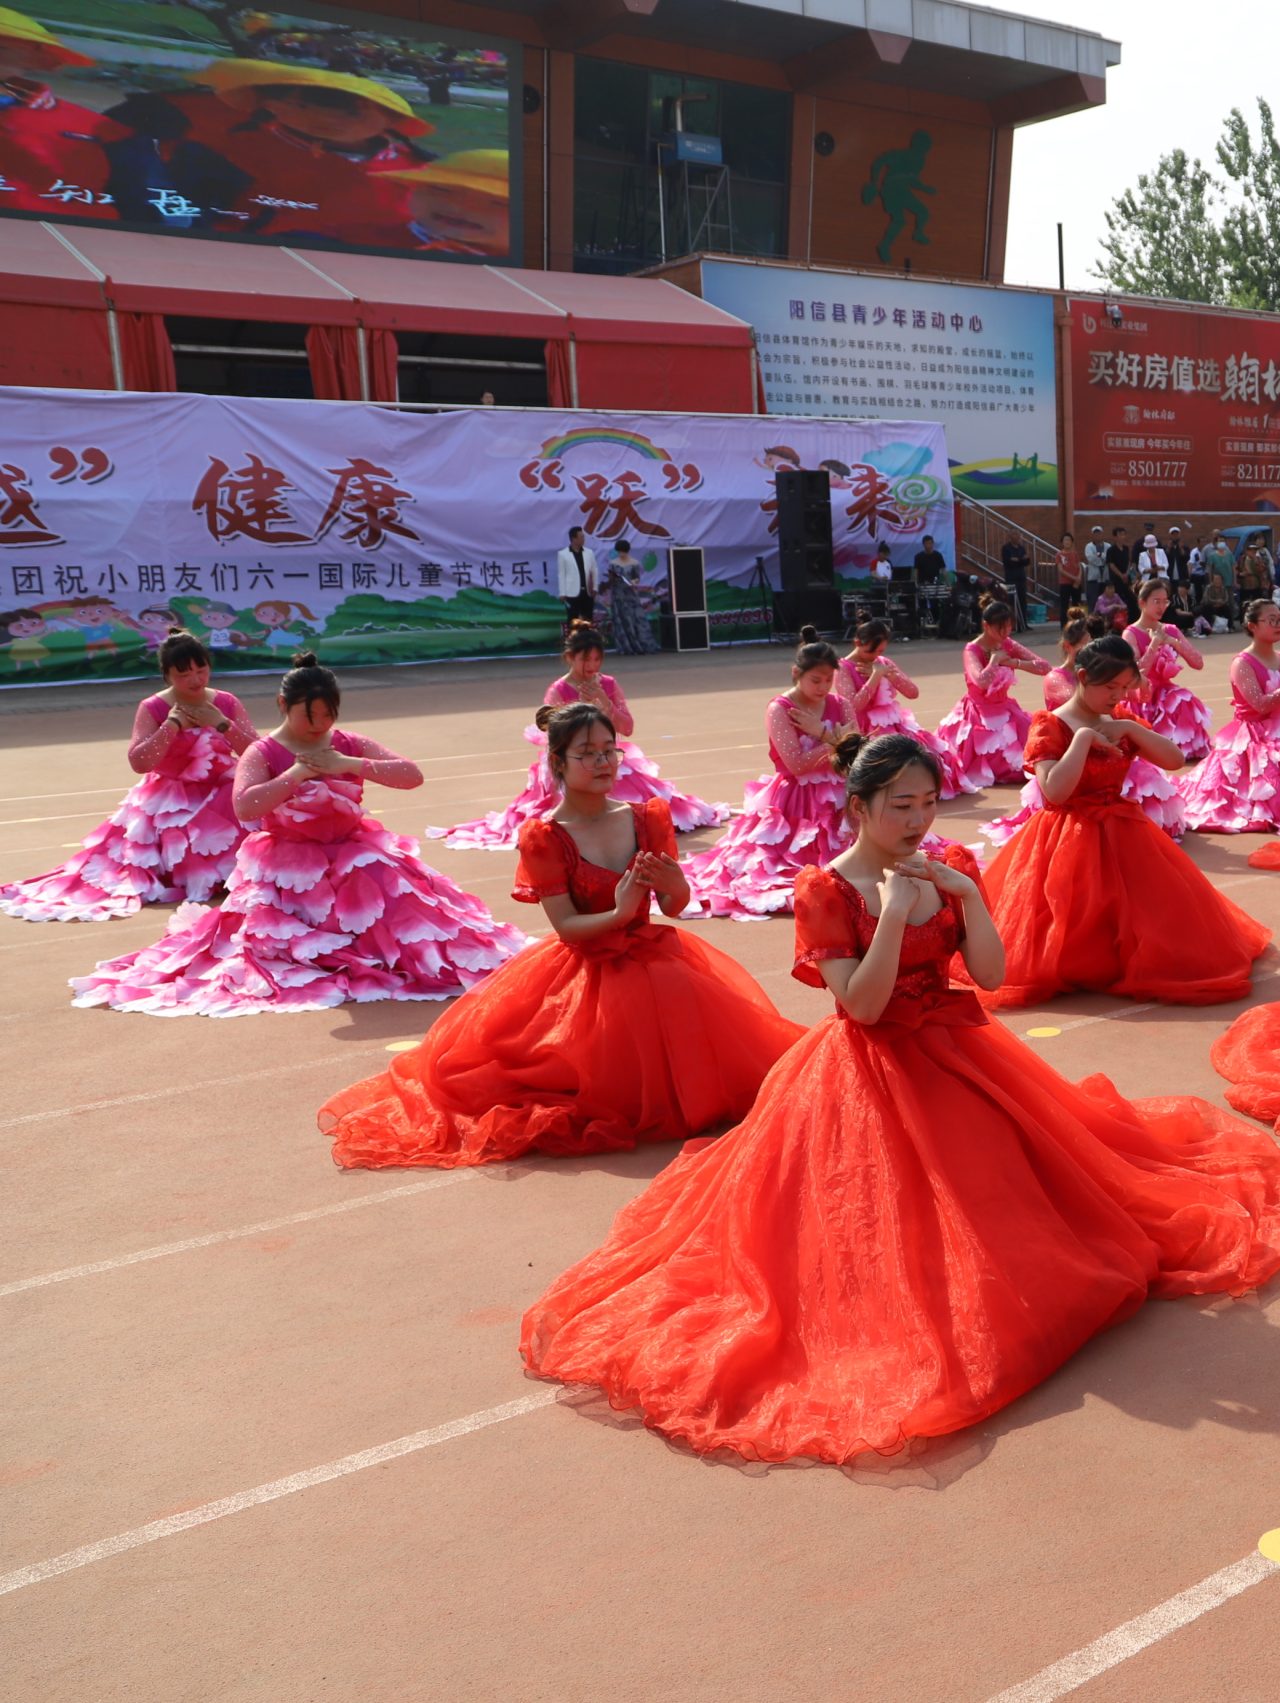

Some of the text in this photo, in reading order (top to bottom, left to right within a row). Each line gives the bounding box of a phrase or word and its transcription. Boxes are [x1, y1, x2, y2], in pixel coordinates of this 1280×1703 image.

[789, 300, 984, 333] 阳信县青少年活动中心
[1128, 460, 1188, 478] 8501777
[193, 453, 422, 549] 健康
[519, 459, 704, 539] “跃”
[761, 463, 906, 540] 来
[0, 561, 549, 595] 团祝小朋友们六一国际儿童节快乐！
